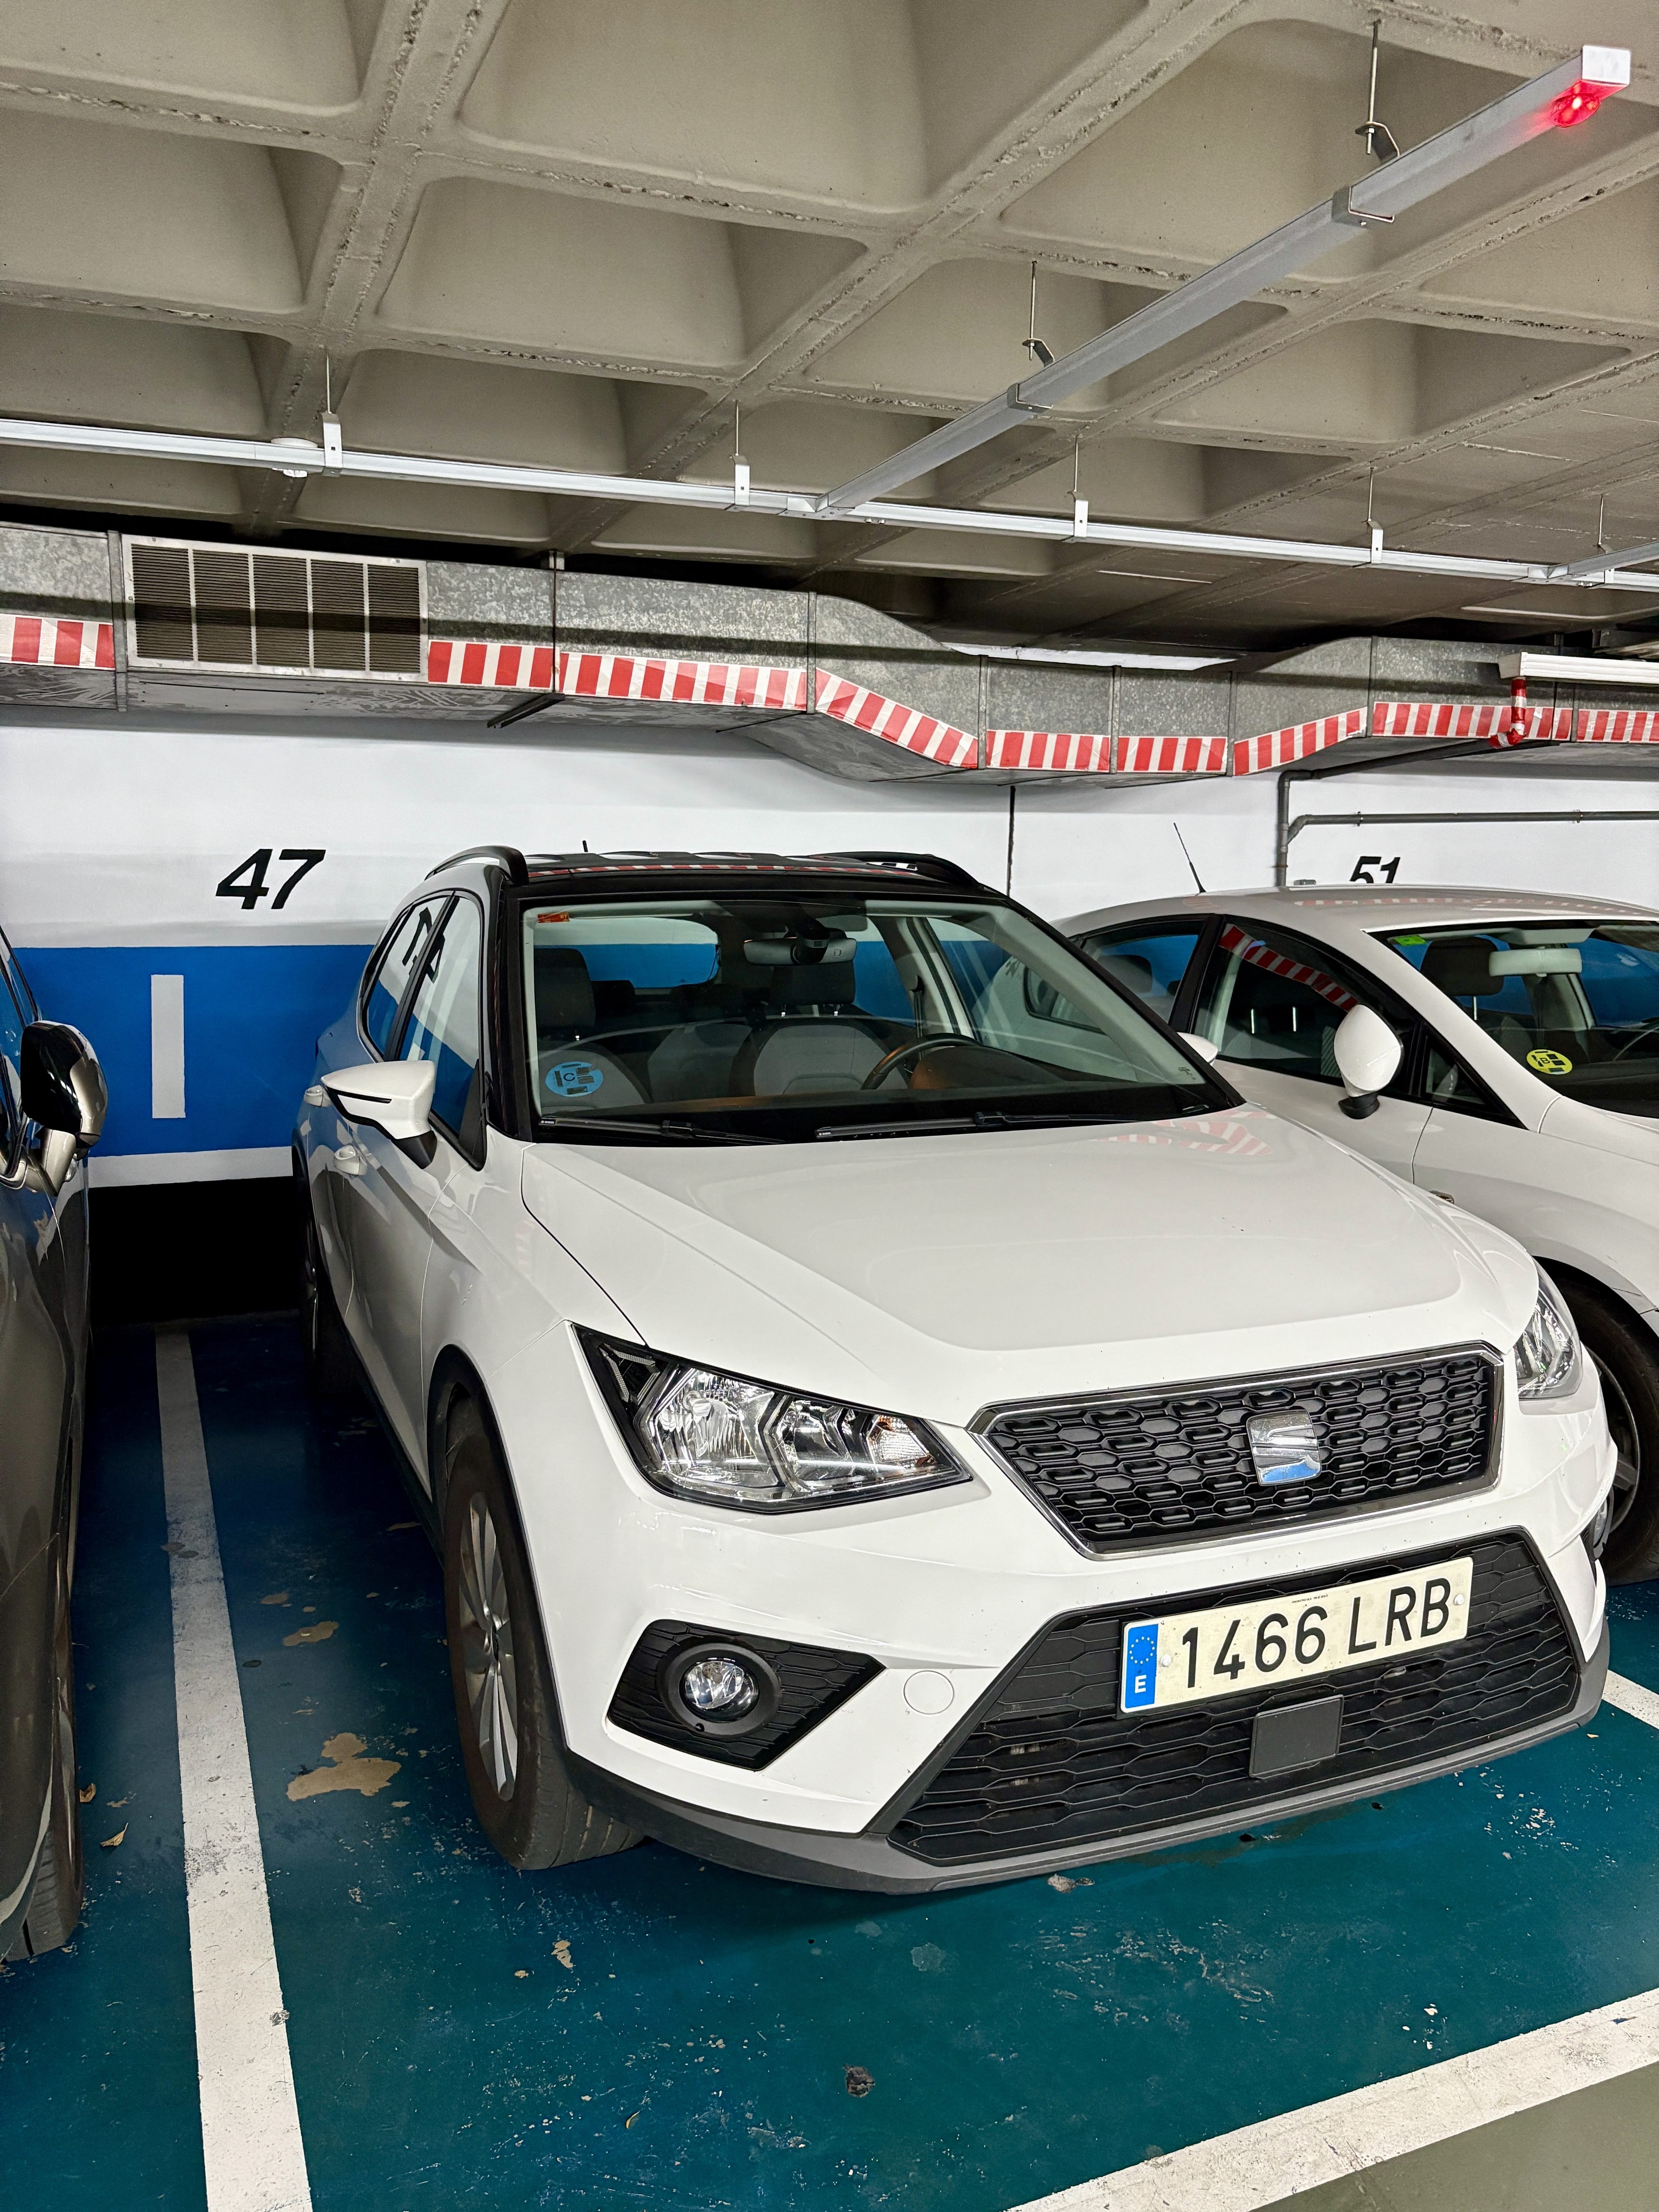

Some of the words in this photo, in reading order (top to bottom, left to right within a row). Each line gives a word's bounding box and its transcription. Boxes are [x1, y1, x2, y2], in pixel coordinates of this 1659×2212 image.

[216, 849, 326, 909] 47
[1349, 856, 1401, 884] 51
[563, 1072, 576, 1082] C
[1182, 1606, 1328, 1688] 1466
[1348, 1578, 1451, 1655] LRB
[1135, 1675, 1147, 1693] E
